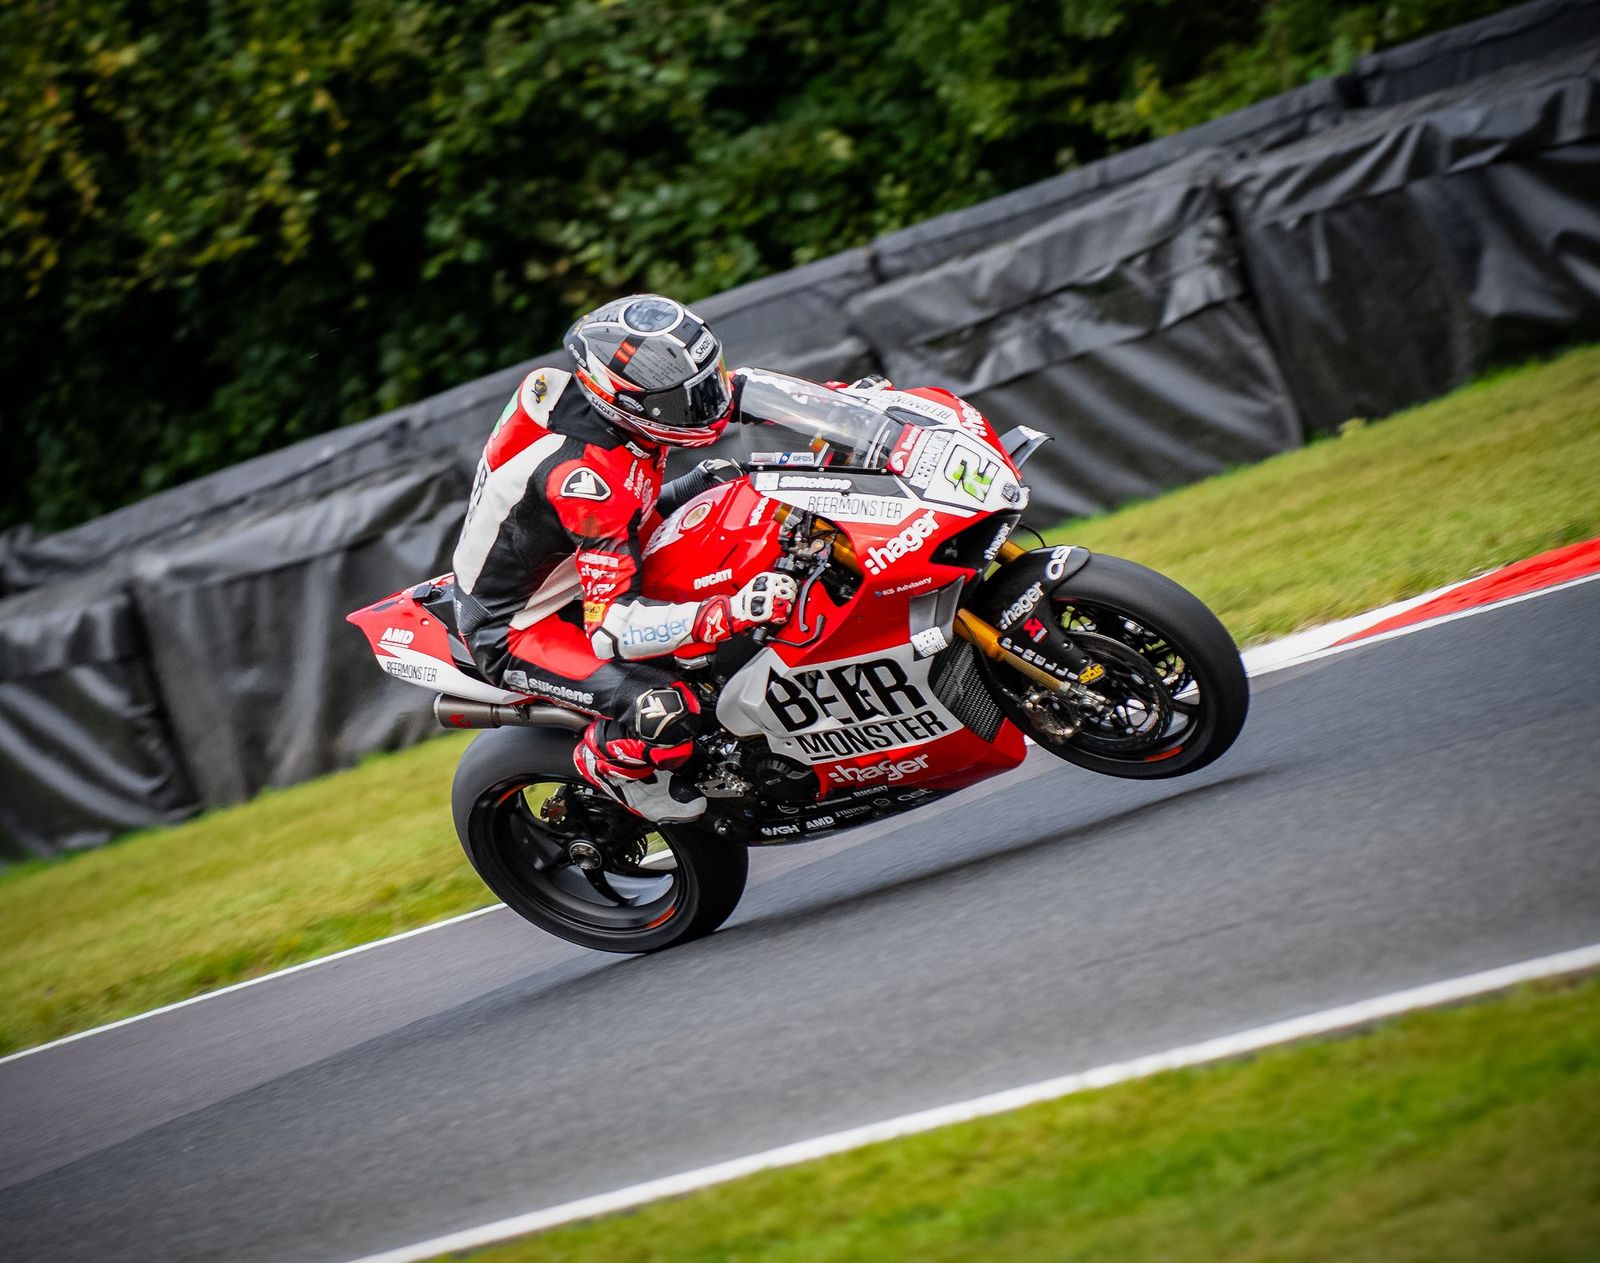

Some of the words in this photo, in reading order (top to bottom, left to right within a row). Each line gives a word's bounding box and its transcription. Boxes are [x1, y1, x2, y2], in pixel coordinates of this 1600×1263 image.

[944, 444, 1000, 503] 2
[808, 495, 902, 519] BEERMONSTER
[694, 568, 733, 590] DUCATI
[896, 576, 932, 594] Advisory
[380, 627, 415, 645] AMD
[1000, 637, 1079, 681] PIRELLI
[386, 660, 437, 682] BEERMONSTER
[765, 658, 929, 733] BEER
[794, 710, 949, 760] MONSTER
[805, 815, 836, 829] AMD
